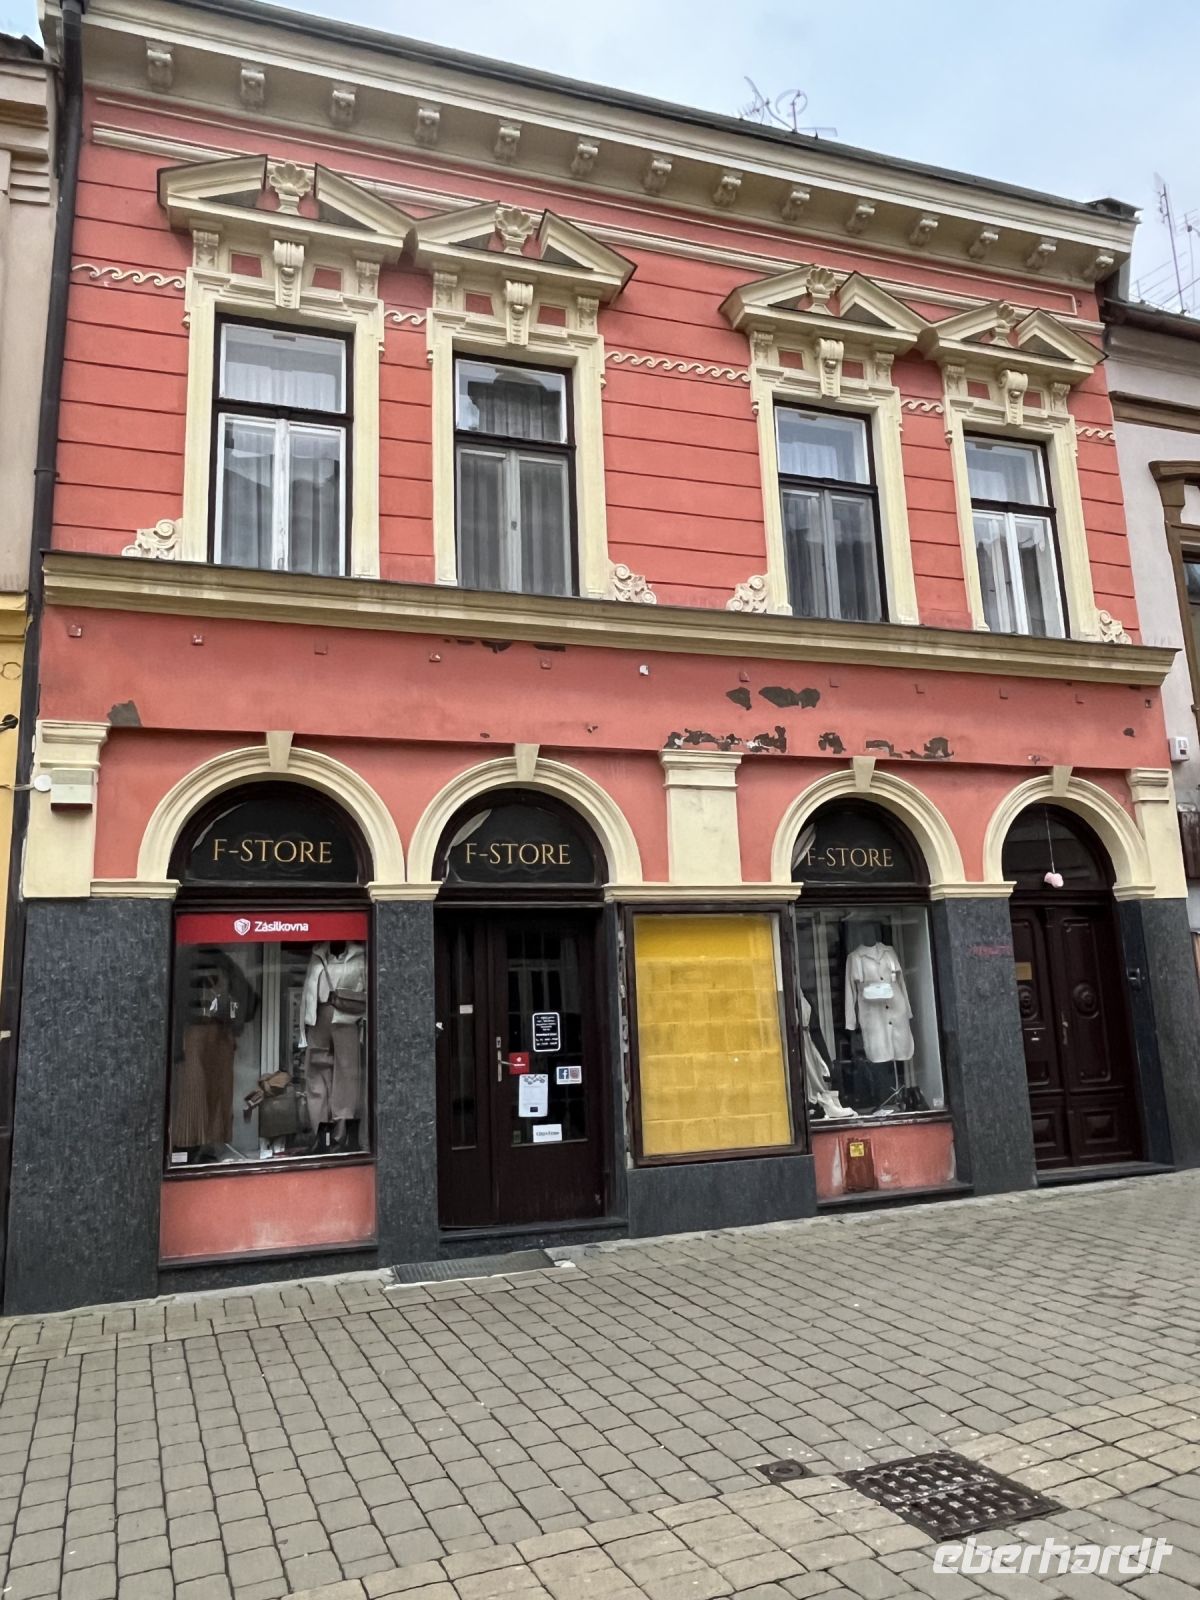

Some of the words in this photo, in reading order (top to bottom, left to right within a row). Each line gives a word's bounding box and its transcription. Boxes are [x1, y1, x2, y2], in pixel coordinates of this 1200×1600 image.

[213, 839, 333, 864] F-STORE
[465, 843, 571, 865] F-STORE
[807, 847, 894, 867] F-STORE
[254, 921, 309, 932] Zásilkovna
